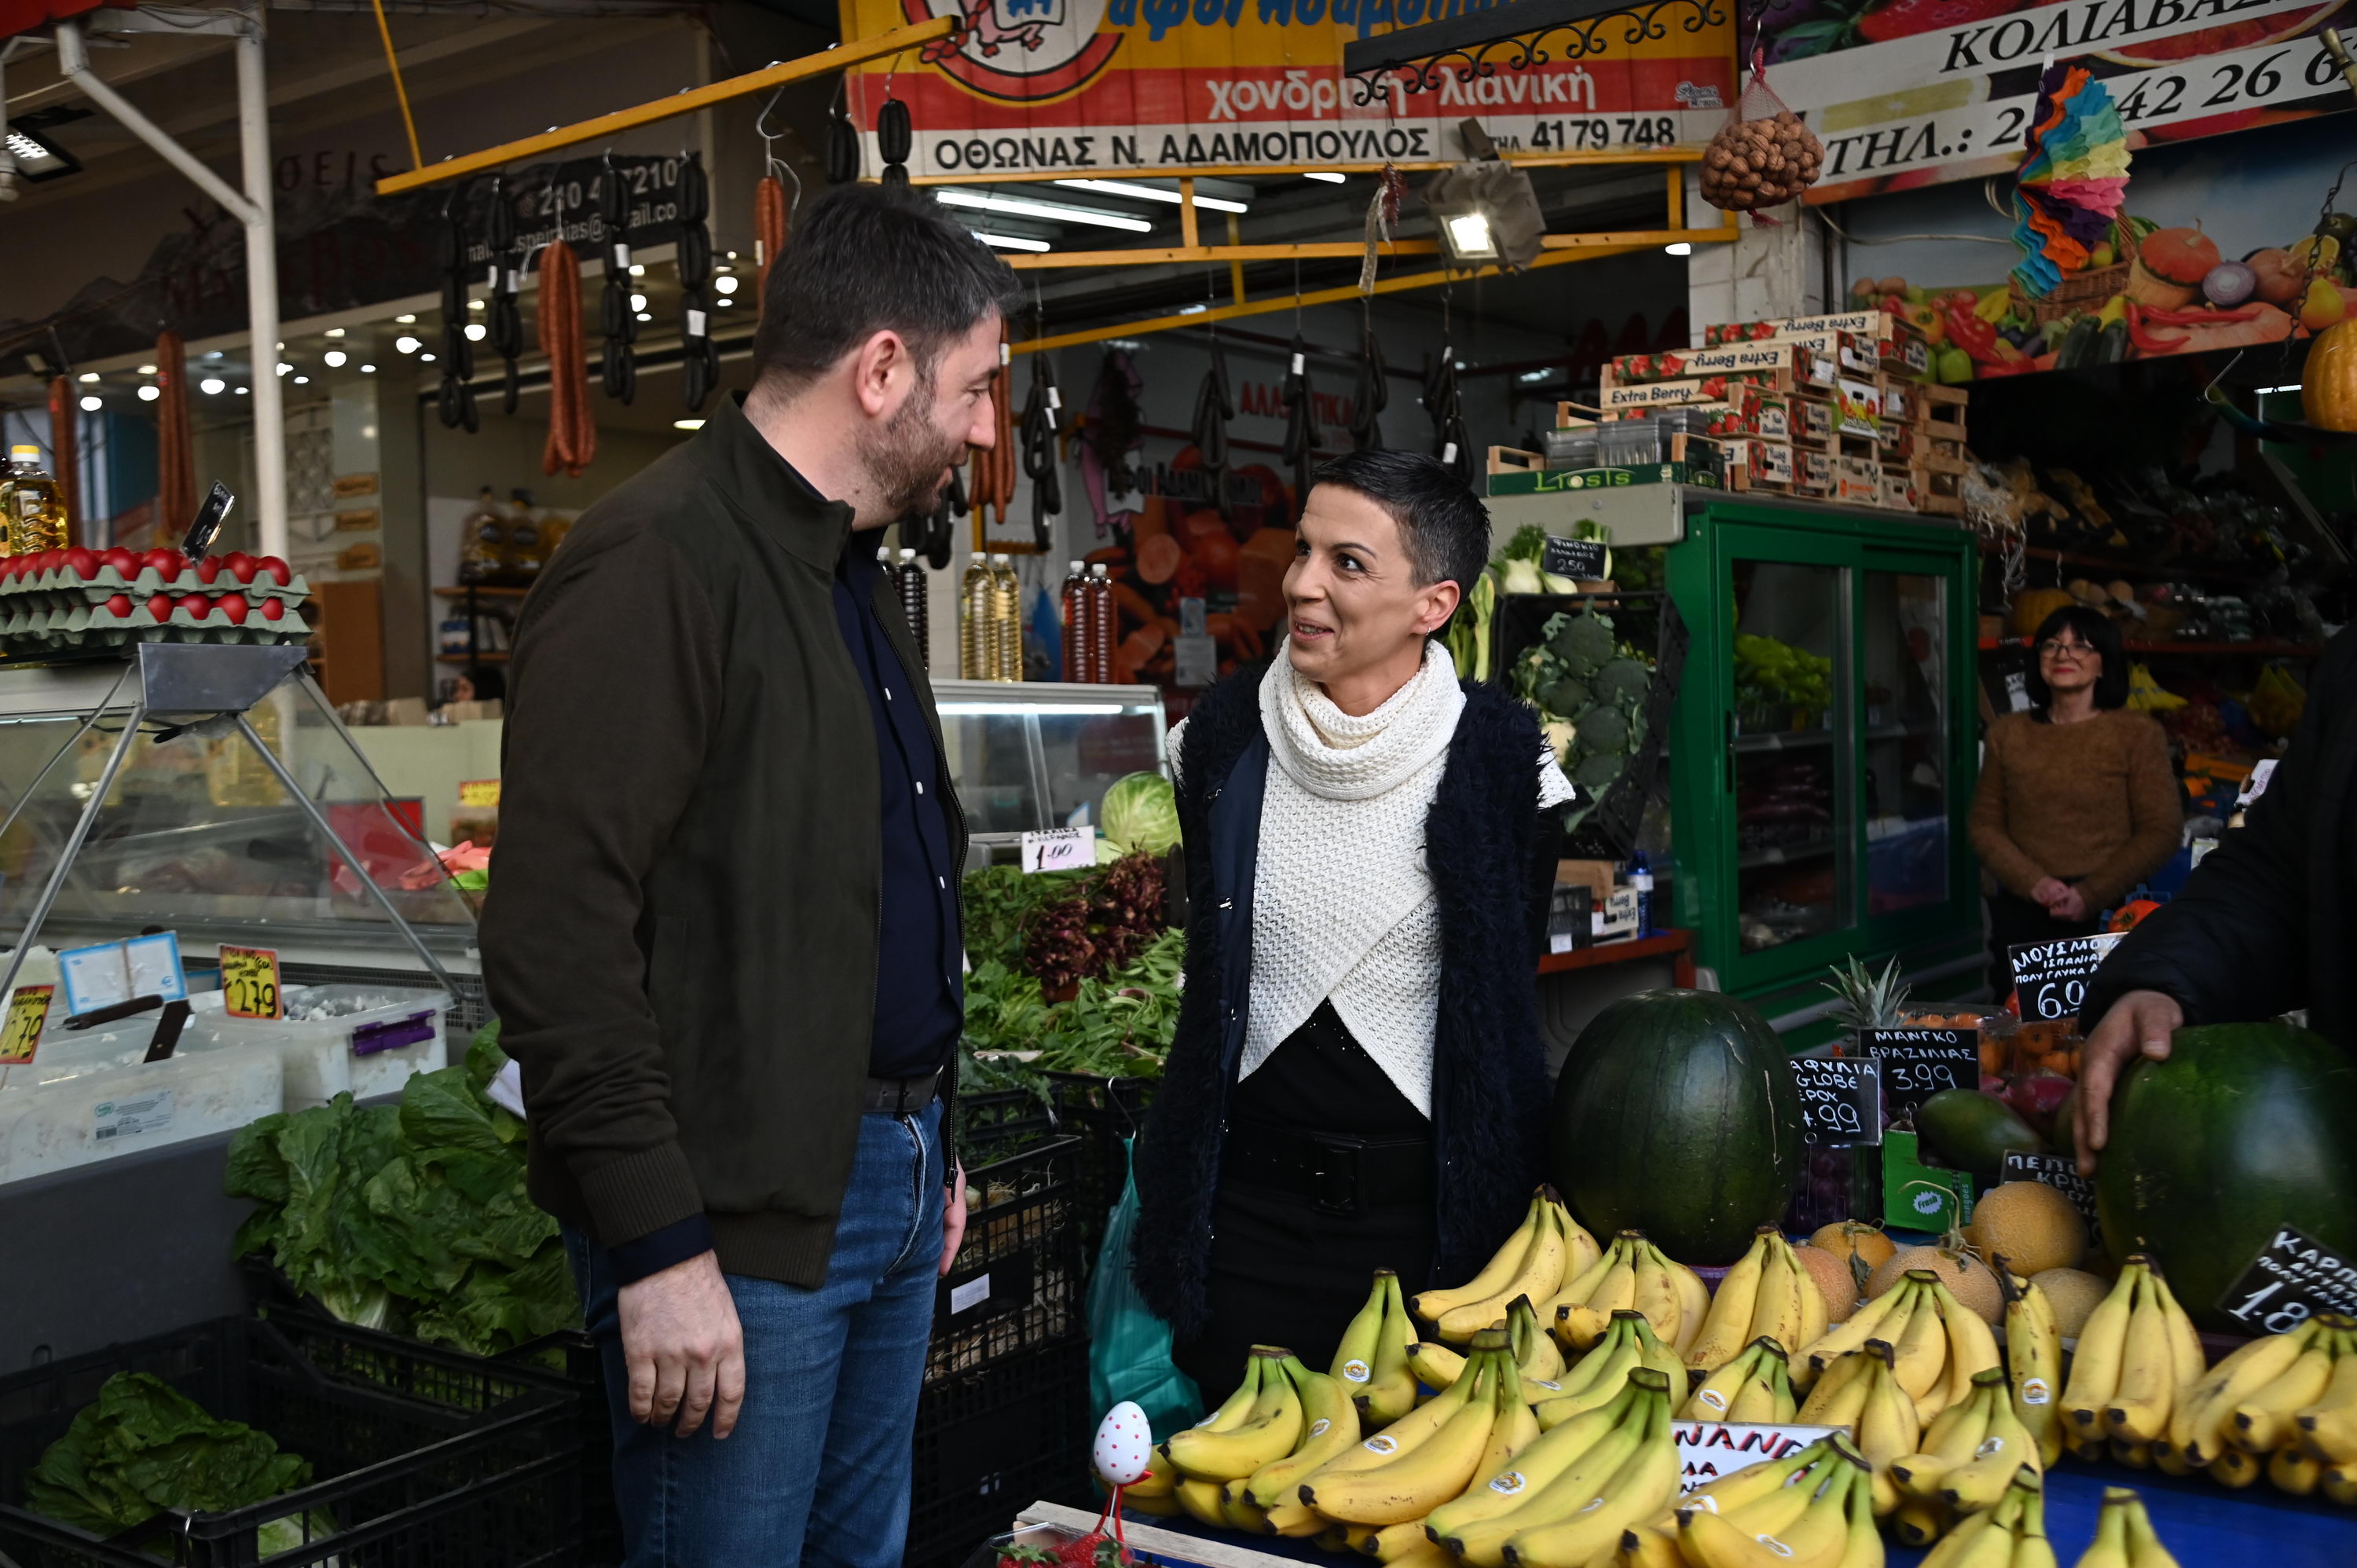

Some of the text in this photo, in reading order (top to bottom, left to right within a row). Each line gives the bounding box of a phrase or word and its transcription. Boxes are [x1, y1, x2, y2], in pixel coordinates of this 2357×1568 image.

[1439, 65, 1596, 110] λιανική
[1826, 117, 1972, 178] ΤΗΛ.:
[2201, 49, 2292, 108] 26
[935, 136, 1097, 170] ΟΘΩΝΑΣ
[1113, 135, 1145, 164] Ν.
[1159, 127, 1430, 163] ΑΔΑΜΟΠΟΥΛΟΣ
[1782, 316, 1867, 332] Extra Berry
[1692, 351, 1779, 368] Extra Berry
[1611, 387, 1694, 404] Extra Berry
[2015, 973, 2042, 984] ΠΟΛΥ
[2047, 967, 2085, 980] ΓΛΥΚΑ
[1875, 1031, 1957, 1044] ΜΑΝΓΚΟ
[1869, 1046, 1978, 1061] ΒΡΑΖΙΛΙΑΣ
[1796, 1073, 1858, 1090] GLOBE
[1892, 1063, 1957, 1091] 3.99
[1917, 1195, 1938, 1210] Fresh
